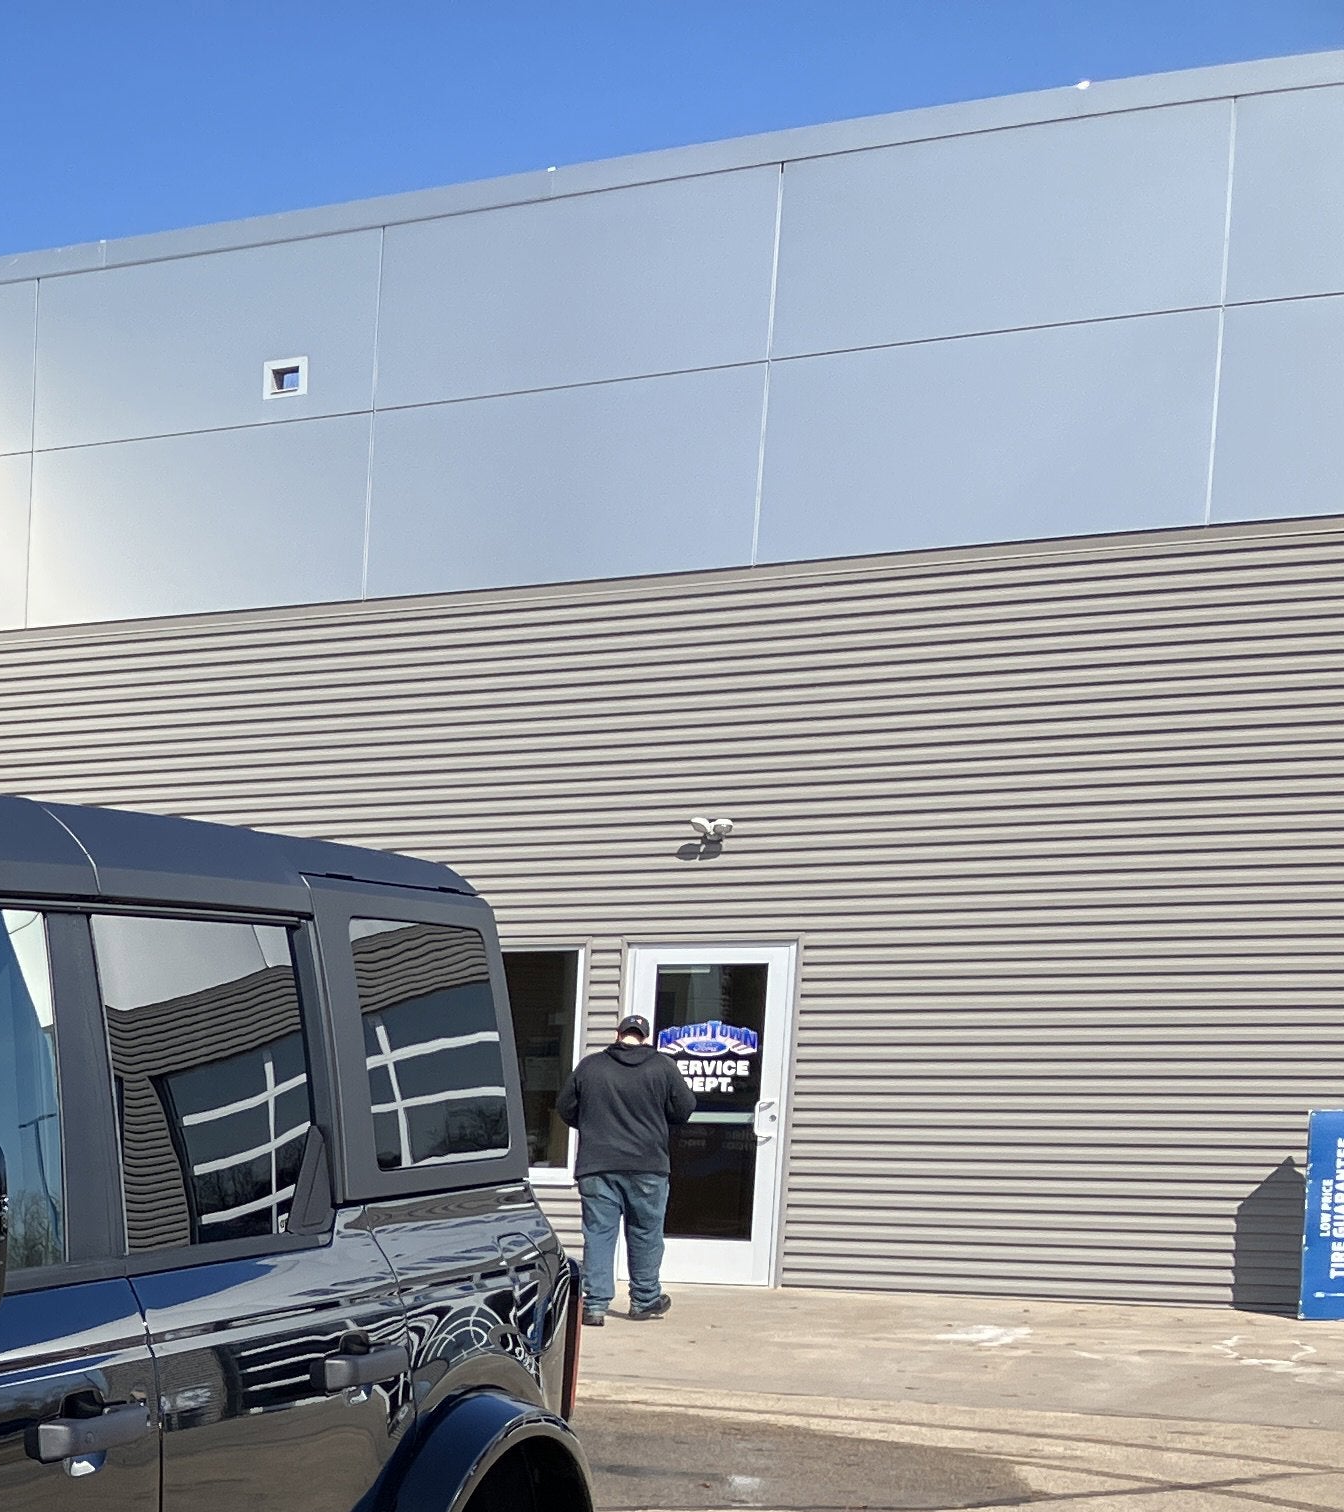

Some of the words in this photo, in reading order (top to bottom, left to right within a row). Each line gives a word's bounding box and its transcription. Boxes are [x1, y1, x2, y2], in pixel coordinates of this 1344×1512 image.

[676, 1060, 750, 1076] ERVICE
[1321, 1179, 1333, 1211] PRICE
[1319, 1212, 1332, 1237] LOW
